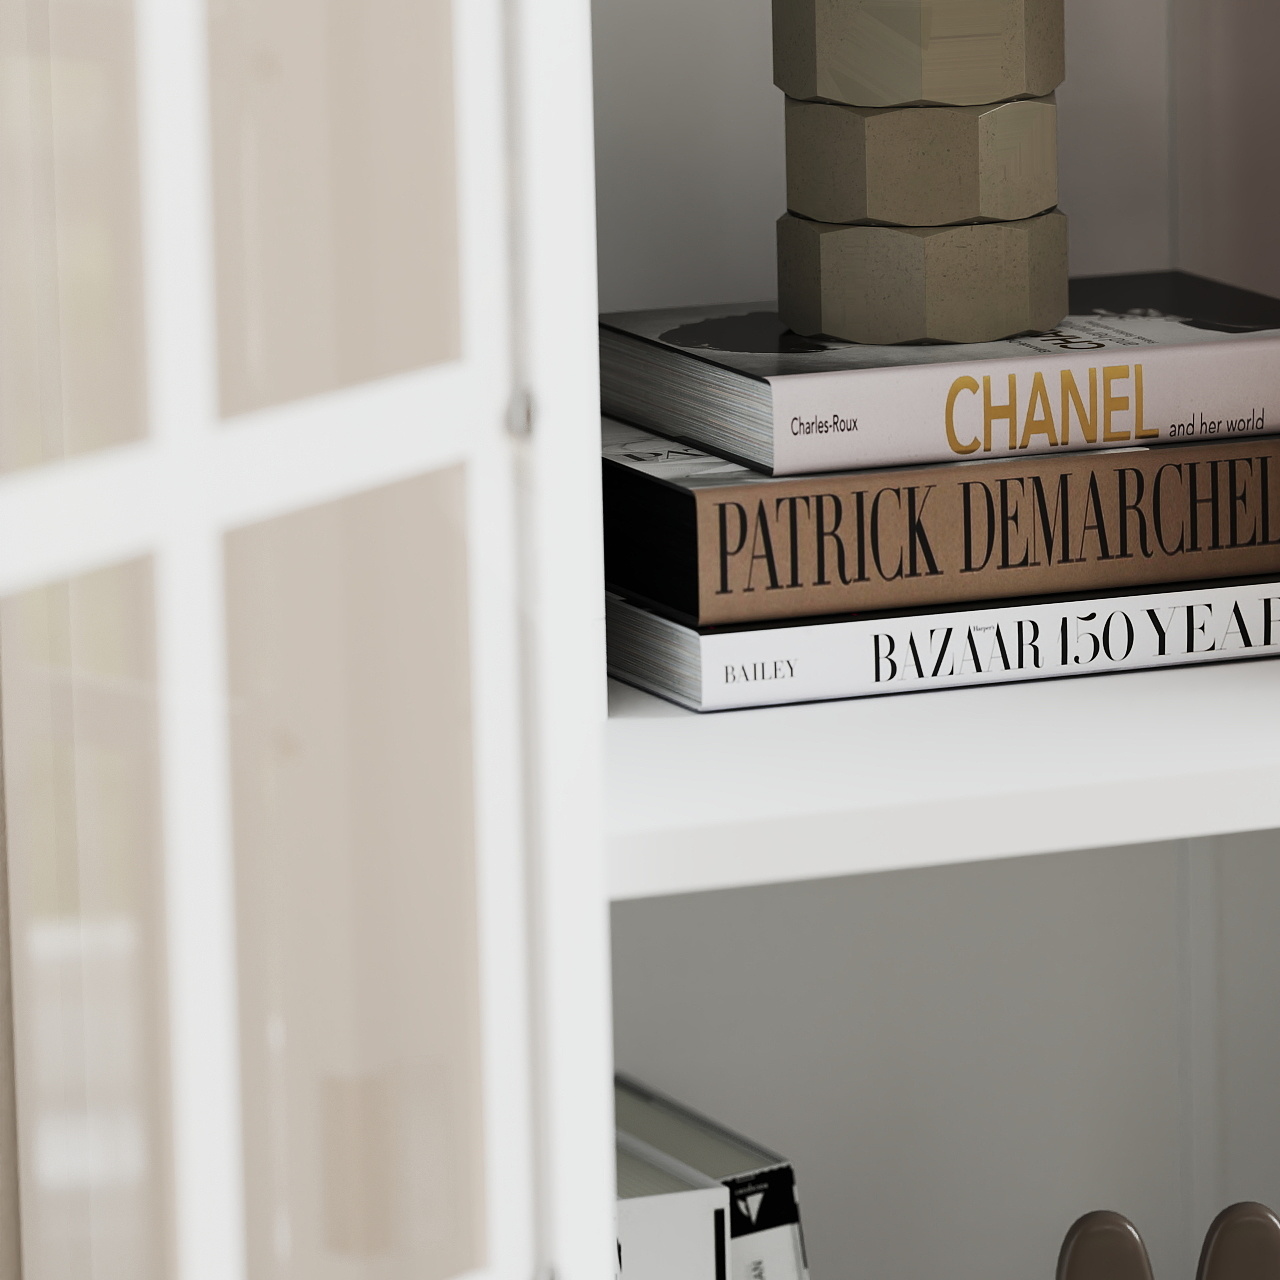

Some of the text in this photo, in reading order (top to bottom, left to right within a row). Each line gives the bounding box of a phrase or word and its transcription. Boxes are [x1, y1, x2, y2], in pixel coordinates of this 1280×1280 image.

[791, 415, 858, 436] Charles-Roux
[945, 363, 1159, 454] CHANEL
[1169, 408, 1265, 437] and her world
[713, 484, 943, 594] PATRICK
[725, 658, 798, 684] BAILEY
[871, 620, 1045, 682] BAZAAR
[1056, 610, 1134, 666] 150
